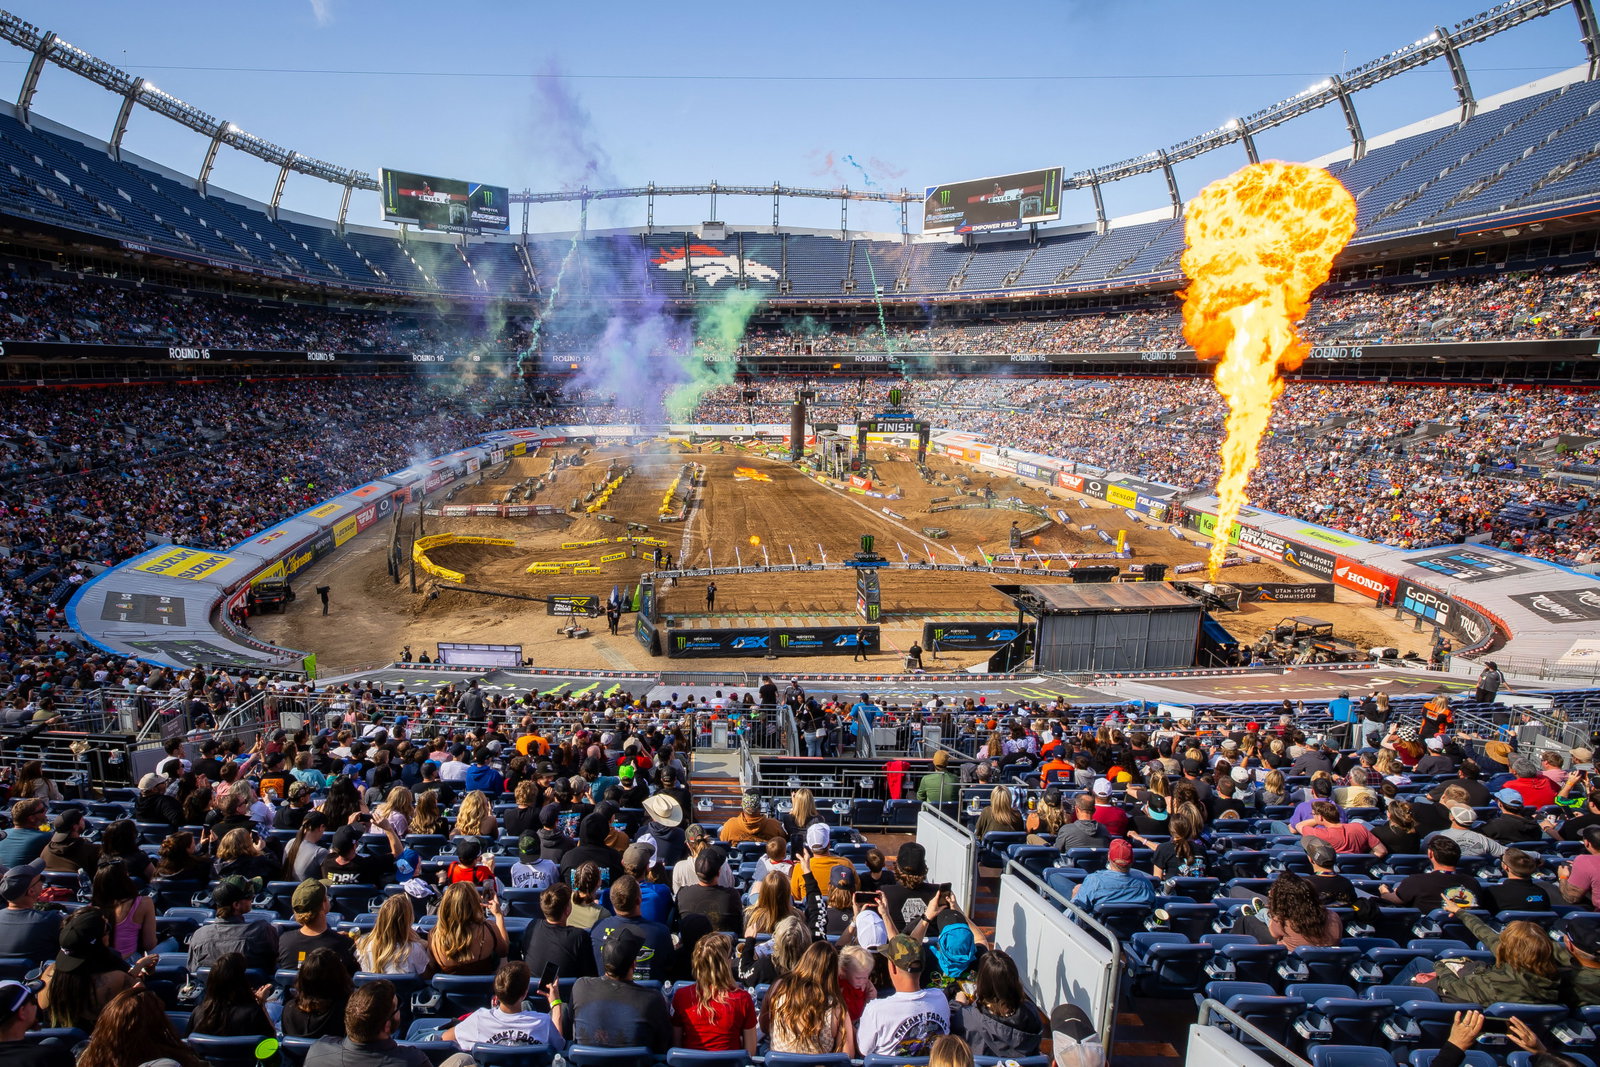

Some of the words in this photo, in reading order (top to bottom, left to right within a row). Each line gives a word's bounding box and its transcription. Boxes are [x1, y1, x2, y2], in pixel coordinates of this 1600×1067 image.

[438, 223, 464, 232] EMPOWER
[464, 226, 479, 234] FIELD
[972, 221, 1000, 232] EMPOWER
[1000, 220, 1018, 230] FIELD
[169, 347, 200, 359] ROUND
[201, 348, 210, 359] 16
[307, 352, 328, 361] ROUND
[328, 352, 335, 361] 16
[412, 354, 436, 362] ROUND
[436, 354, 445, 362] 16
[1010, 354, 1037, 362] ROUND
[1141, 351, 1167, 361] ROUND
[1168, 351, 1177, 360] 16
[1308, 347, 1347, 359] ROUND
[1350, 346, 1363, 358] 16
[877, 422, 914, 432] FINISH
[1085, 488, 1104, 498] OAKLEY
[1112, 491, 1135, 502] DUNLOP
[1137, 496, 1167, 510] FALKEN
[146, 549, 199, 573] SUZUKI
[602, 553, 625, 561] SUZUKI
[1300, 551, 1313, 560] UTAH
[1313, 555, 1334, 568] SPORTS
[178, 555, 227, 579] SUZUKI
[1298, 558, 1333, 575] COMMISSION
[1346, 571, 1391, 593] HONDA
[1406, 586, 1449, 613] GoPro
[894, 1012, 924, 1040] SNEAKY
[925, 1011, 948, 1031] FARMS
